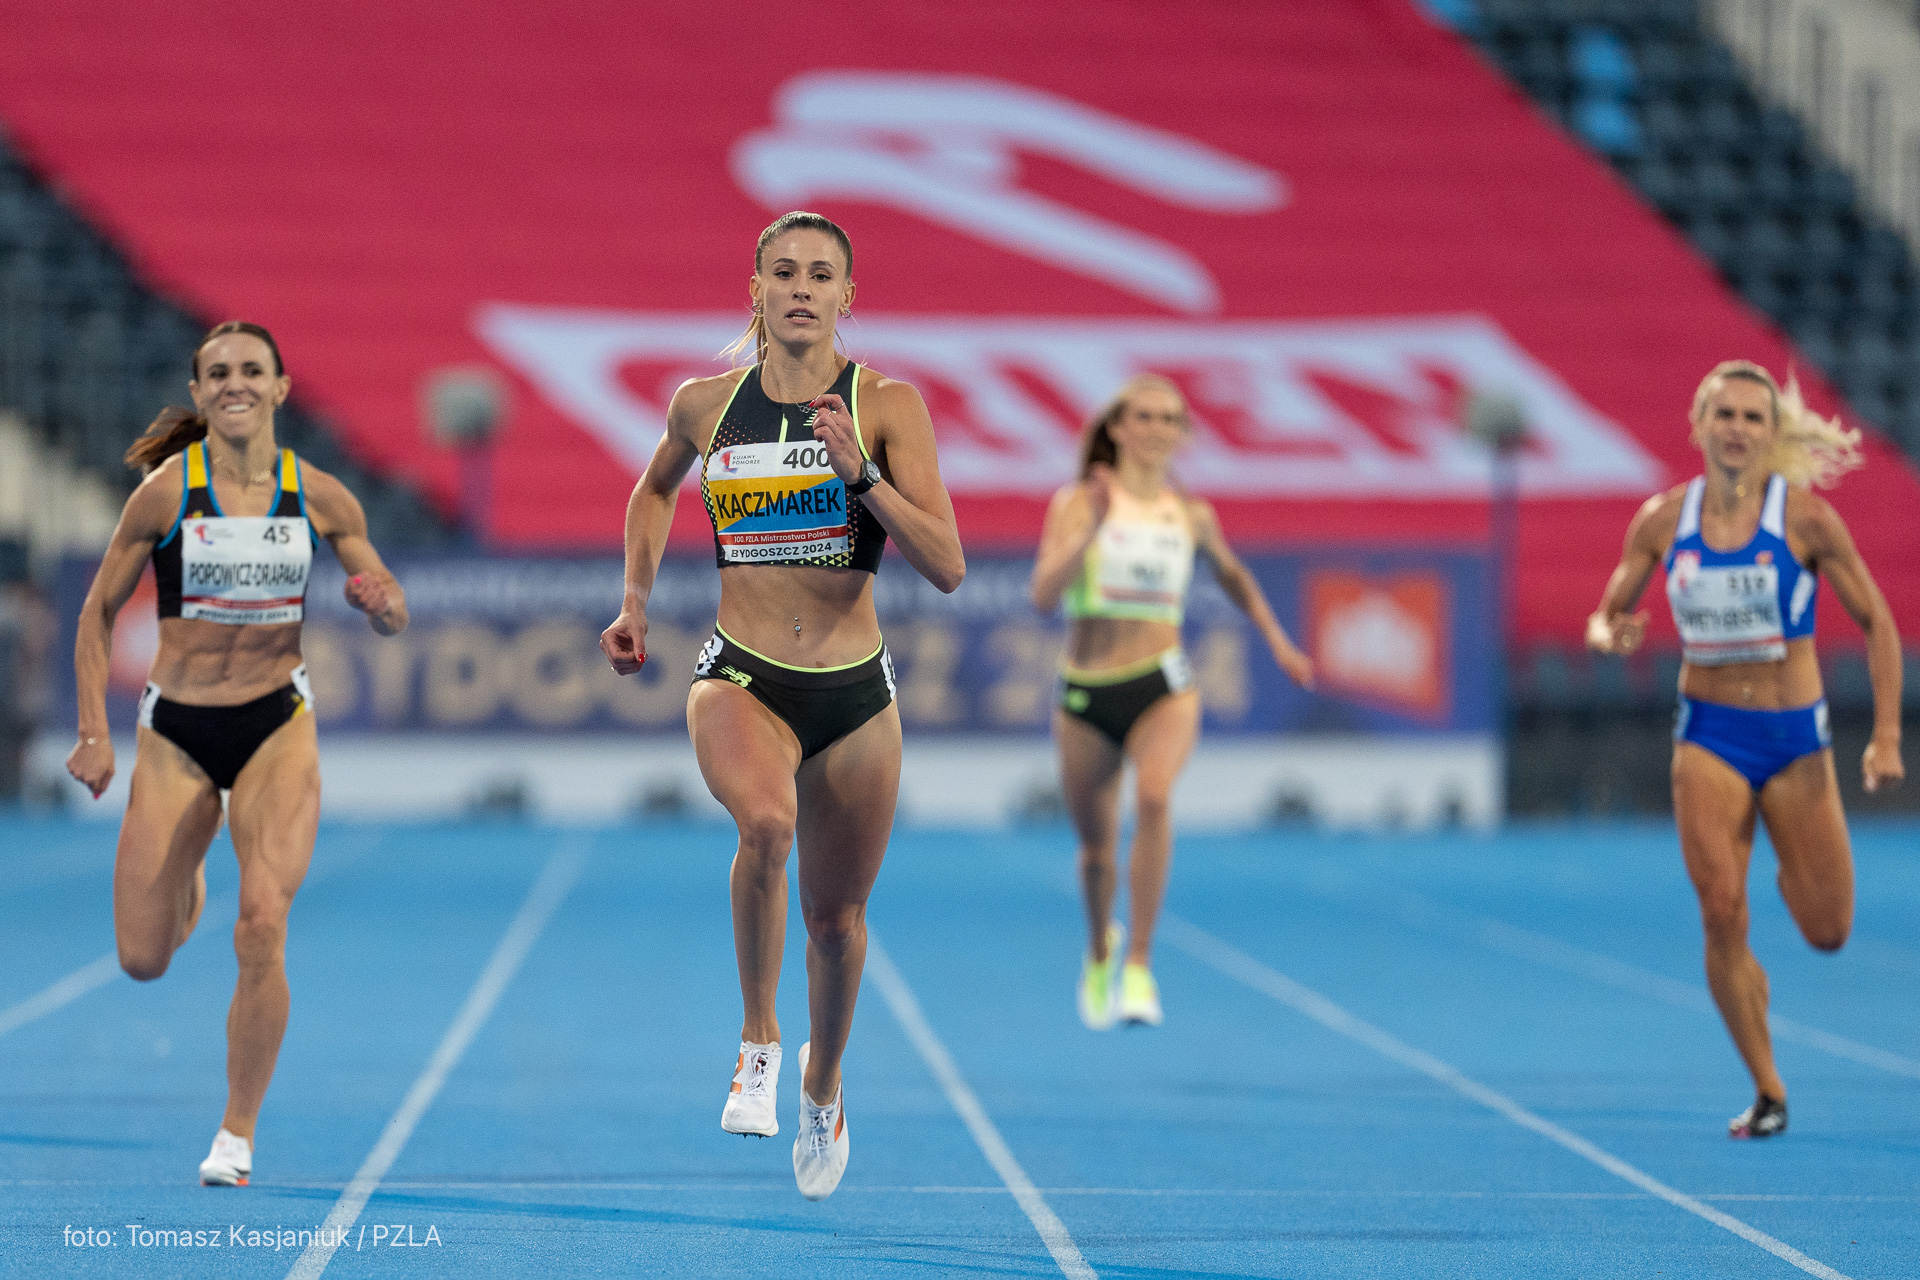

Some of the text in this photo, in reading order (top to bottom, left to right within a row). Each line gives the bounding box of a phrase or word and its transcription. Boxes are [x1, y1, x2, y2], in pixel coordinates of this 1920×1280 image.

[782, 448, 830, 469] 400
[715, 487, 842, 519] KACZMAREK
[262, 525, 291, 545] 45
[760, 533, 806, 542] Mistrzostwa
[807, 530, 830, 540] Polski
[731, 542, 832, 558] BYDGOSZCZ 2024
